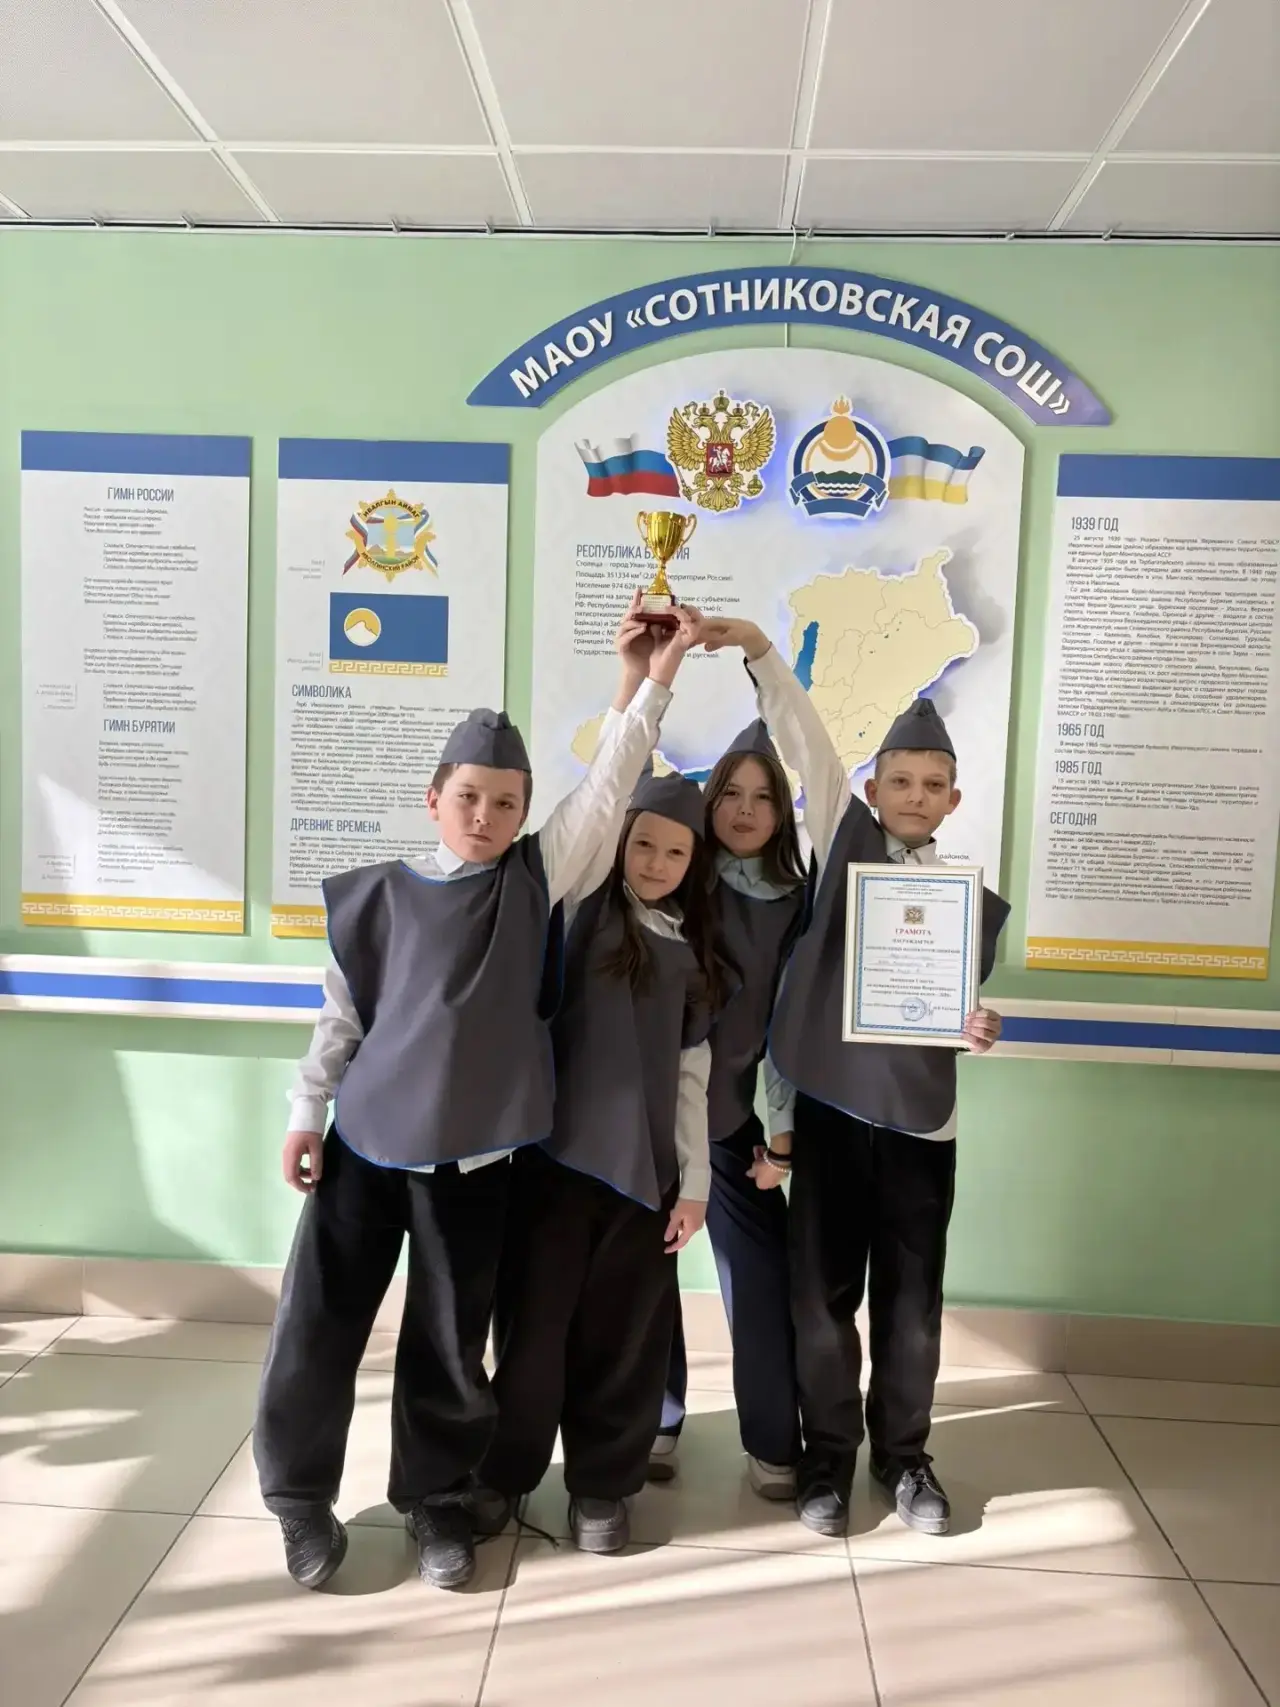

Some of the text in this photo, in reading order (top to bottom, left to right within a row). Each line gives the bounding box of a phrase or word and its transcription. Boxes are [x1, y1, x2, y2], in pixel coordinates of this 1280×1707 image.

[509, 278, 1072, 416] МАОУ «СОТНИКОВСКАЯ СОШ»
[107, 487, 174, 501] ГИМН РОССИИ
[1071, 516, 1119, 532] 1939 ГОД
[577, 544, 641, 559] РЕСПУБЛИКА
[292, 684, 352, 698] СИМВОЛИКА
[103, 719, 175, 734] ГИМН БУРЯТИИ
[1058, 723, 1104, 738] 1965 ГОД
[1055, 760, 1102, 775] 1985 ГОД
[290, 818, 381, 833] ДРЕВНИЕ ВРЕМЕНА
[1050, 812, 1097, 826] СЕГОДНЯ
[895, 928, 932, 936] ГРАМОТА
